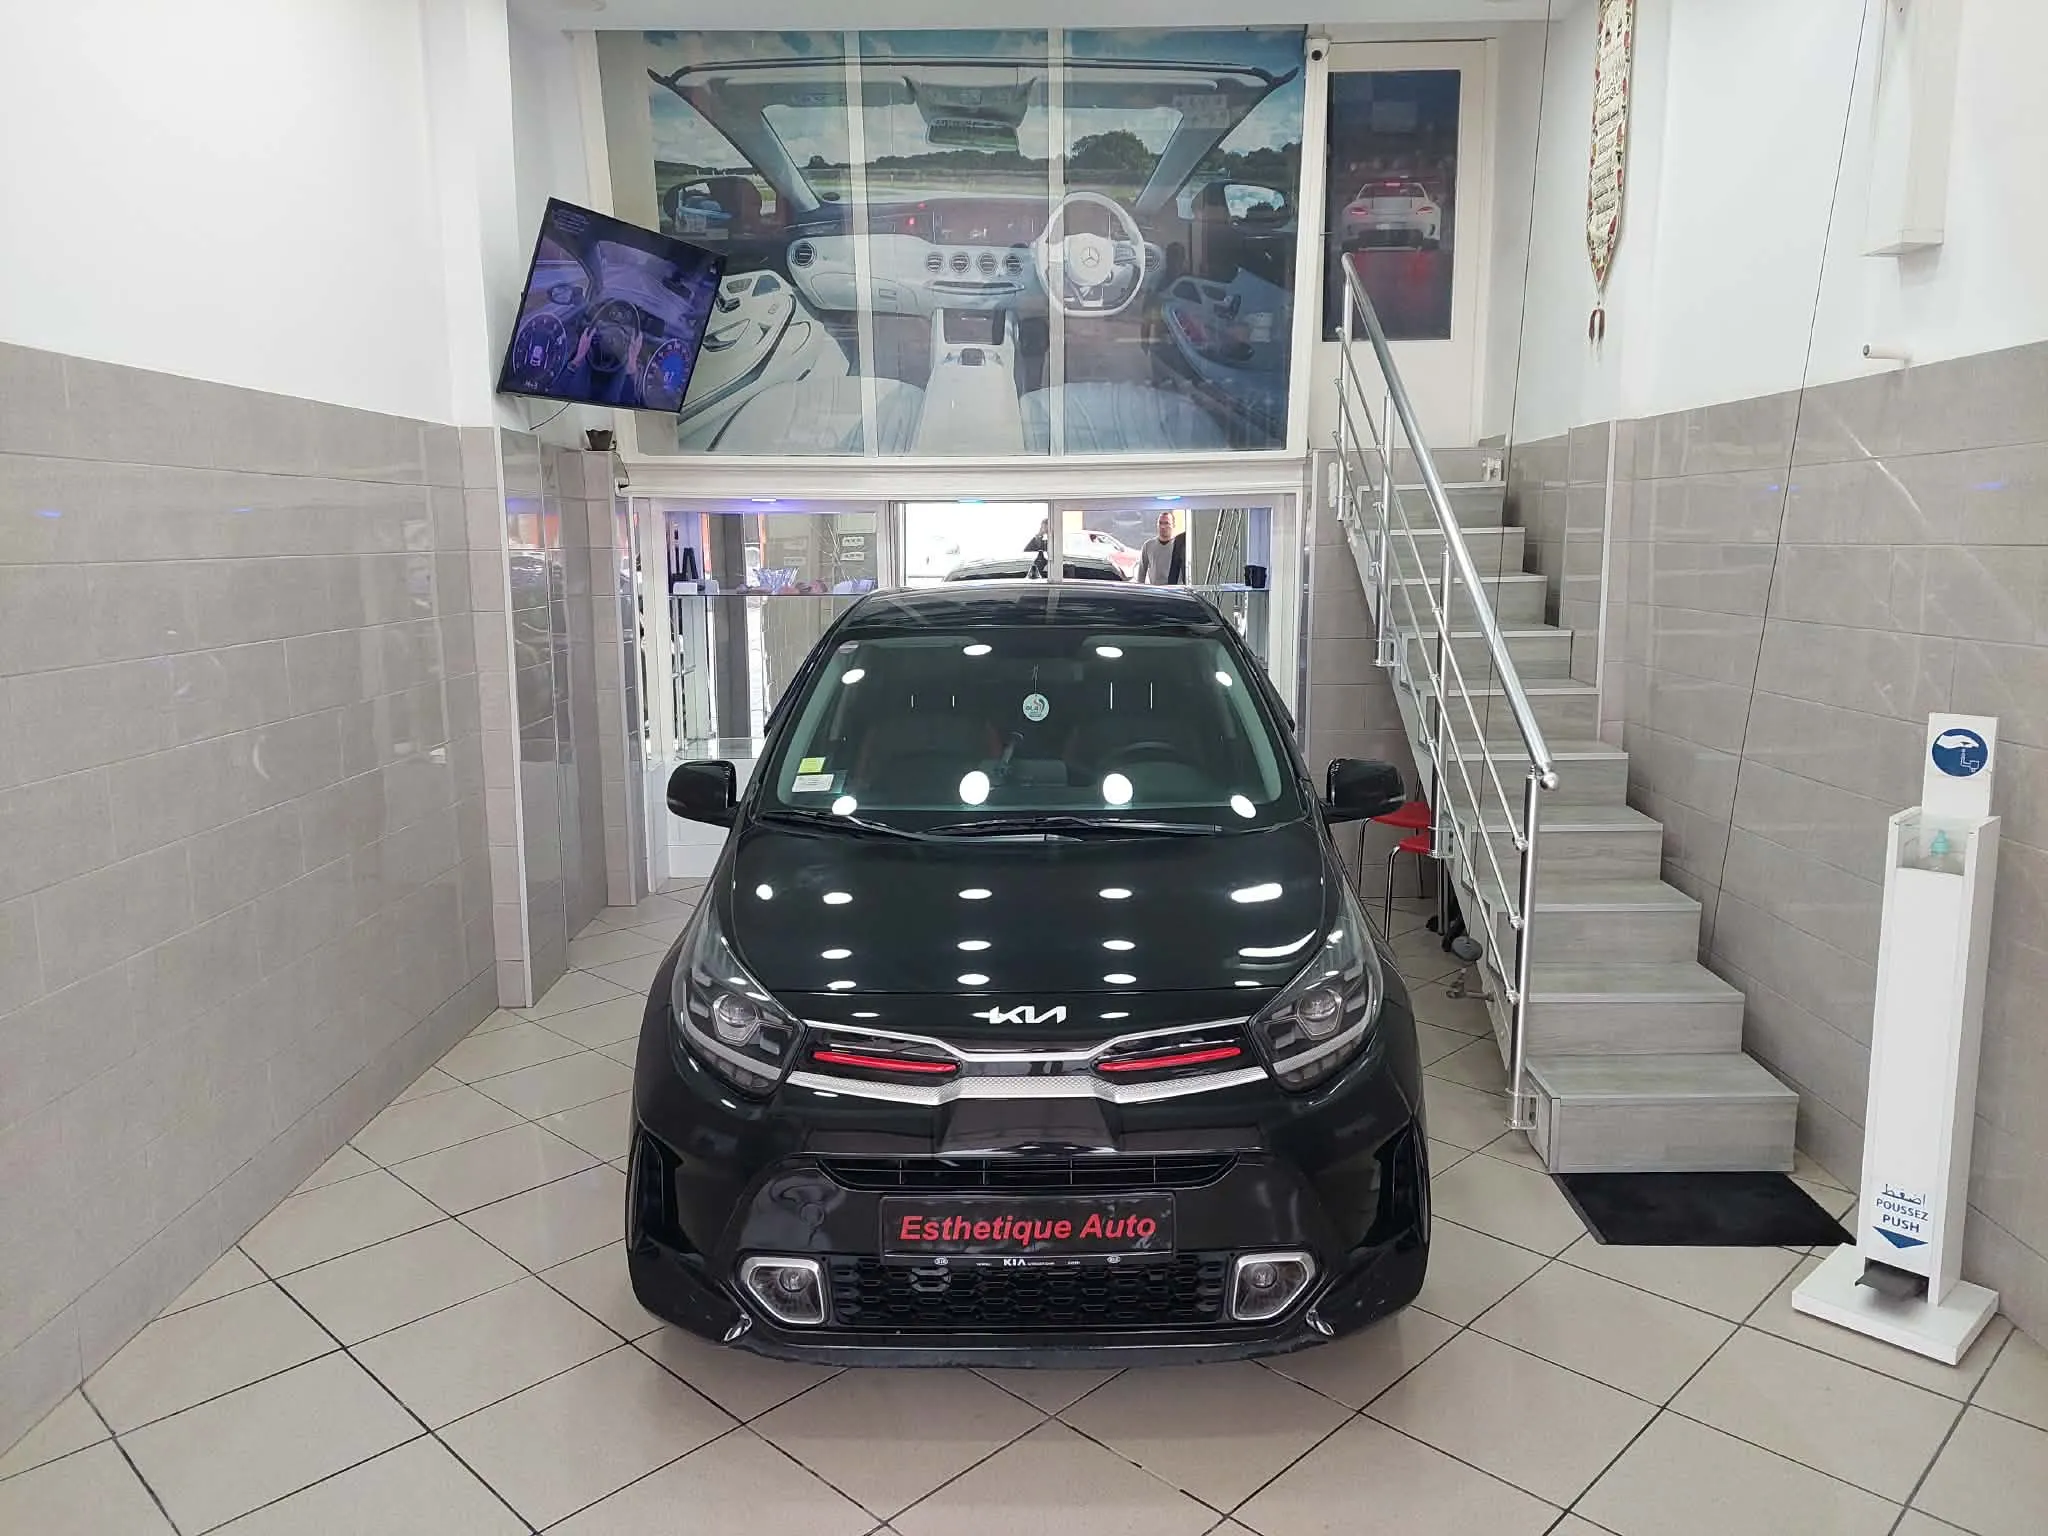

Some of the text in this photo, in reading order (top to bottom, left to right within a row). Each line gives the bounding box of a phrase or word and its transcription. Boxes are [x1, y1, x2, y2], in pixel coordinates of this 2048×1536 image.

[1881, 1183, 1926, 1206] اضغط
[1876, 1198, 1929, 1221] POUSSEZ
[900, 1214, 1156, 1246] Esthetique Auto
[1882, 1214, 1920, 1233] PUSH
[1003, 1258, 1026, 1266] KIA
